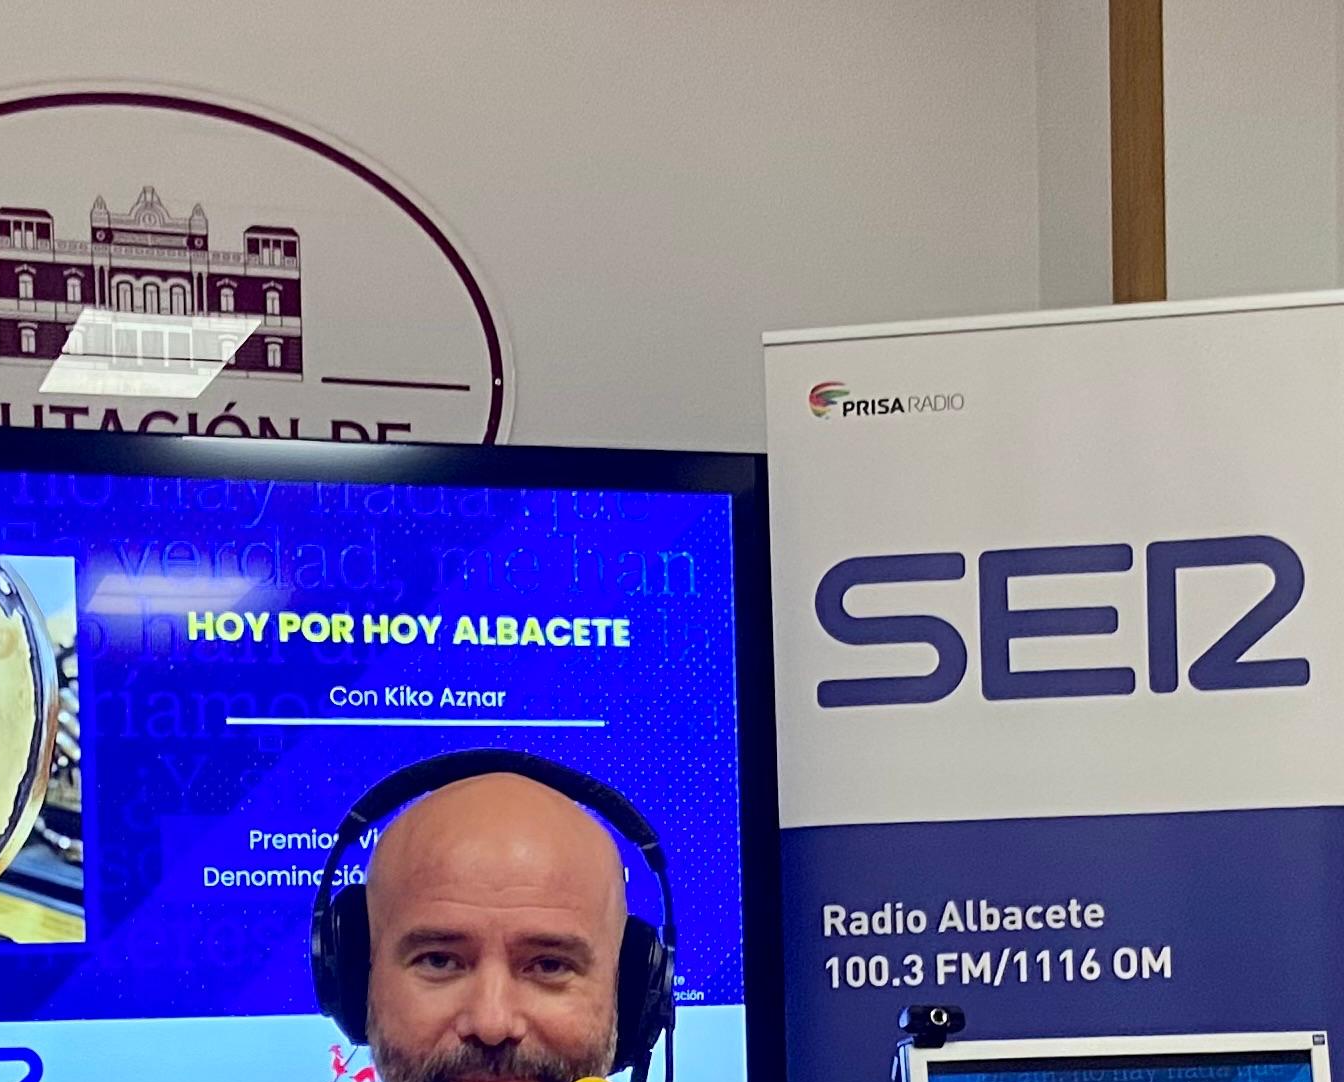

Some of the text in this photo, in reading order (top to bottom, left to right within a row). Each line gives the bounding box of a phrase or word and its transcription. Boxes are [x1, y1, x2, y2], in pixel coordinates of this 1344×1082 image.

[842, 392, 965, 418] PRISA RADIO
[187, 611, 270, 642] HOY
[279, 613, 354, 644] POR
[363, 614, 442, 644] HOY
[453, 616, 631, 648] ALBACETE
[814, 534, 1310, 708] SER
[329, 685, 506, 708] Con Kiko Aznar
[823, 898, 1105, 937] Radio Albacete
[825, 945, 1173, 989] 100.3 FM/1116 OM
